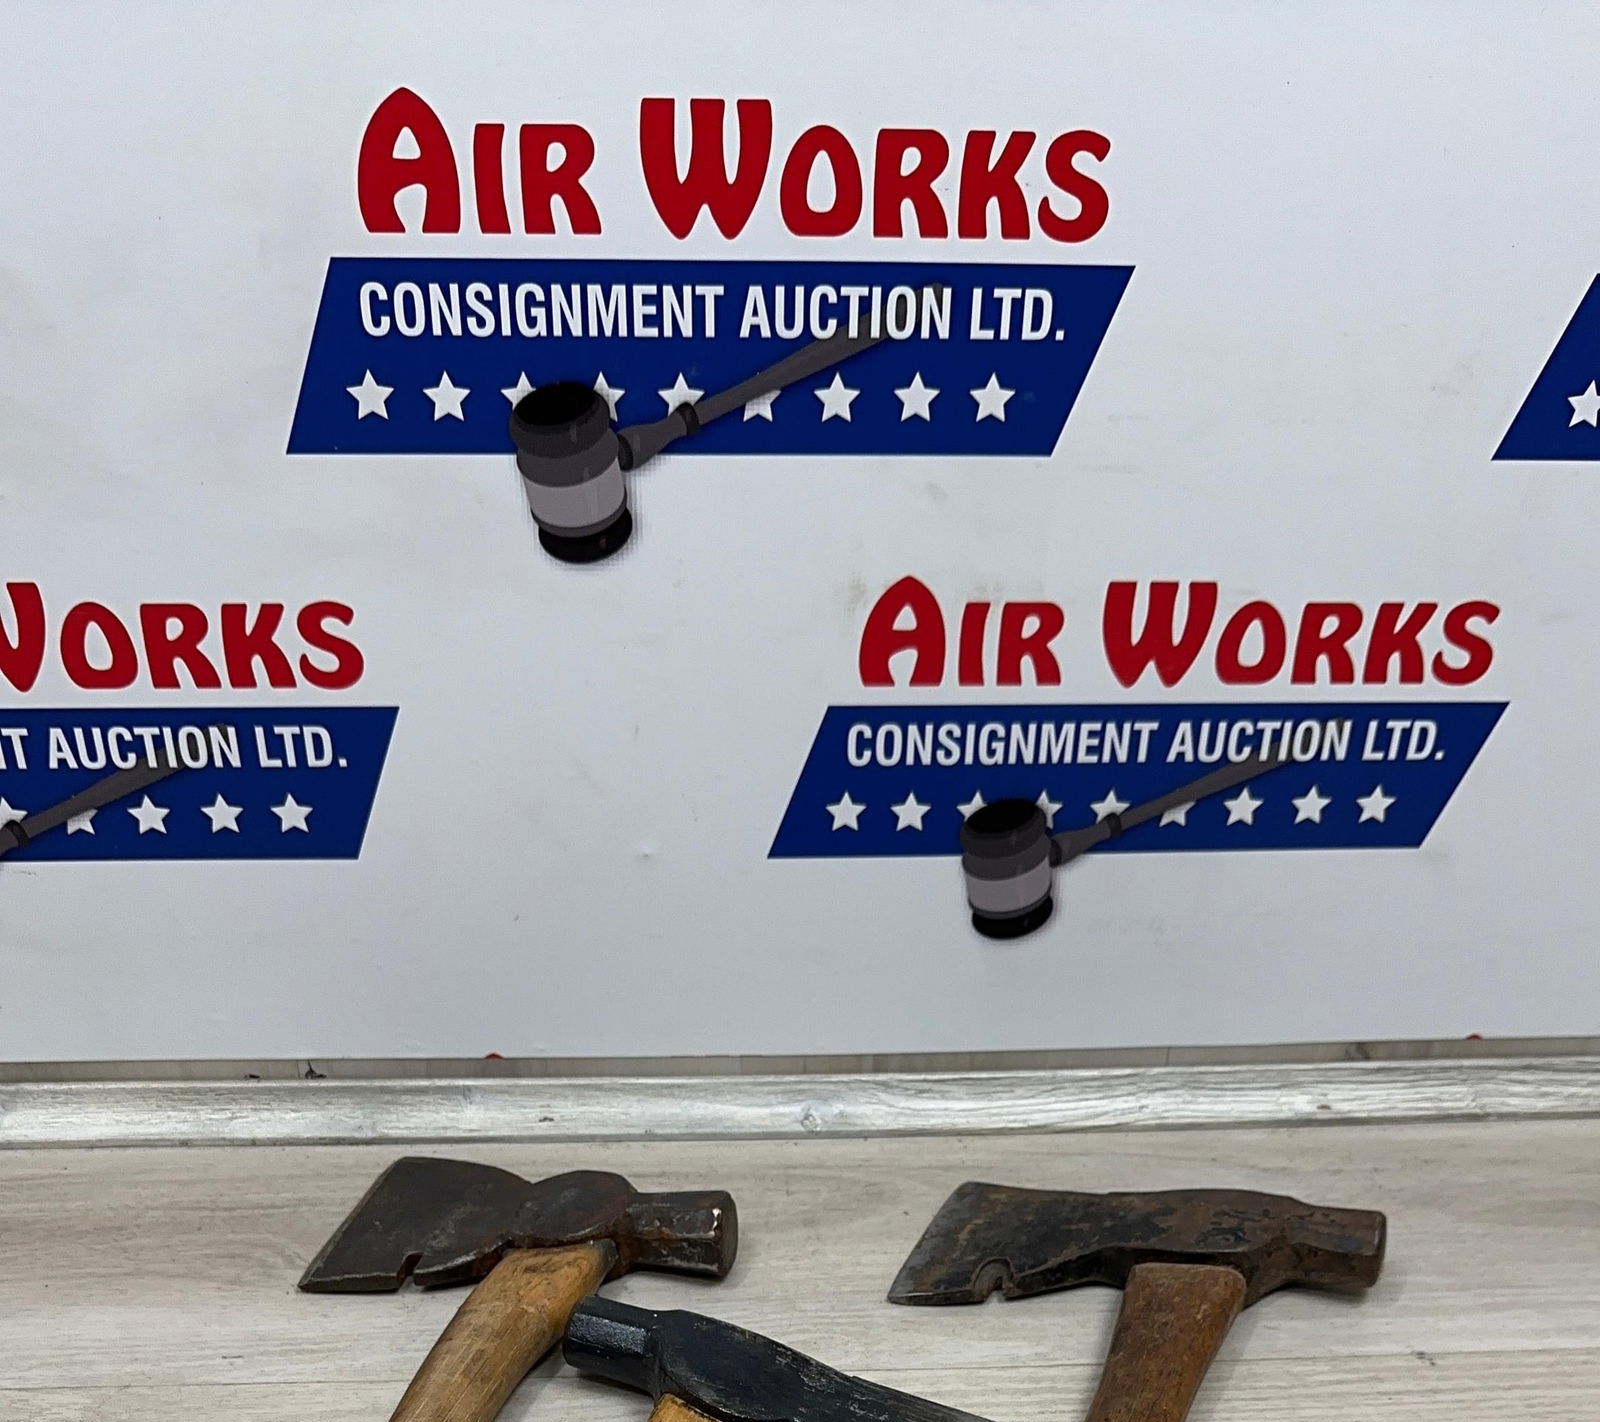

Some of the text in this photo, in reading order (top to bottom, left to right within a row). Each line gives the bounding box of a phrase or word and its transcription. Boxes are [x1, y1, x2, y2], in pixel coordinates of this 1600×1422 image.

[357, 86, 1112, 243] AIR WORKS
[359, 281, 1066, 342] CONSIGNMENT AUCTION LTD.
[858, 575, 1501, 689] AIR WORKS
[48, 725, 242, 770] AUCTION
[253, 725, 348, 769] LTD.
[846, 719, 1446, 767] CONSIGNMENT AUCTION LTD.
